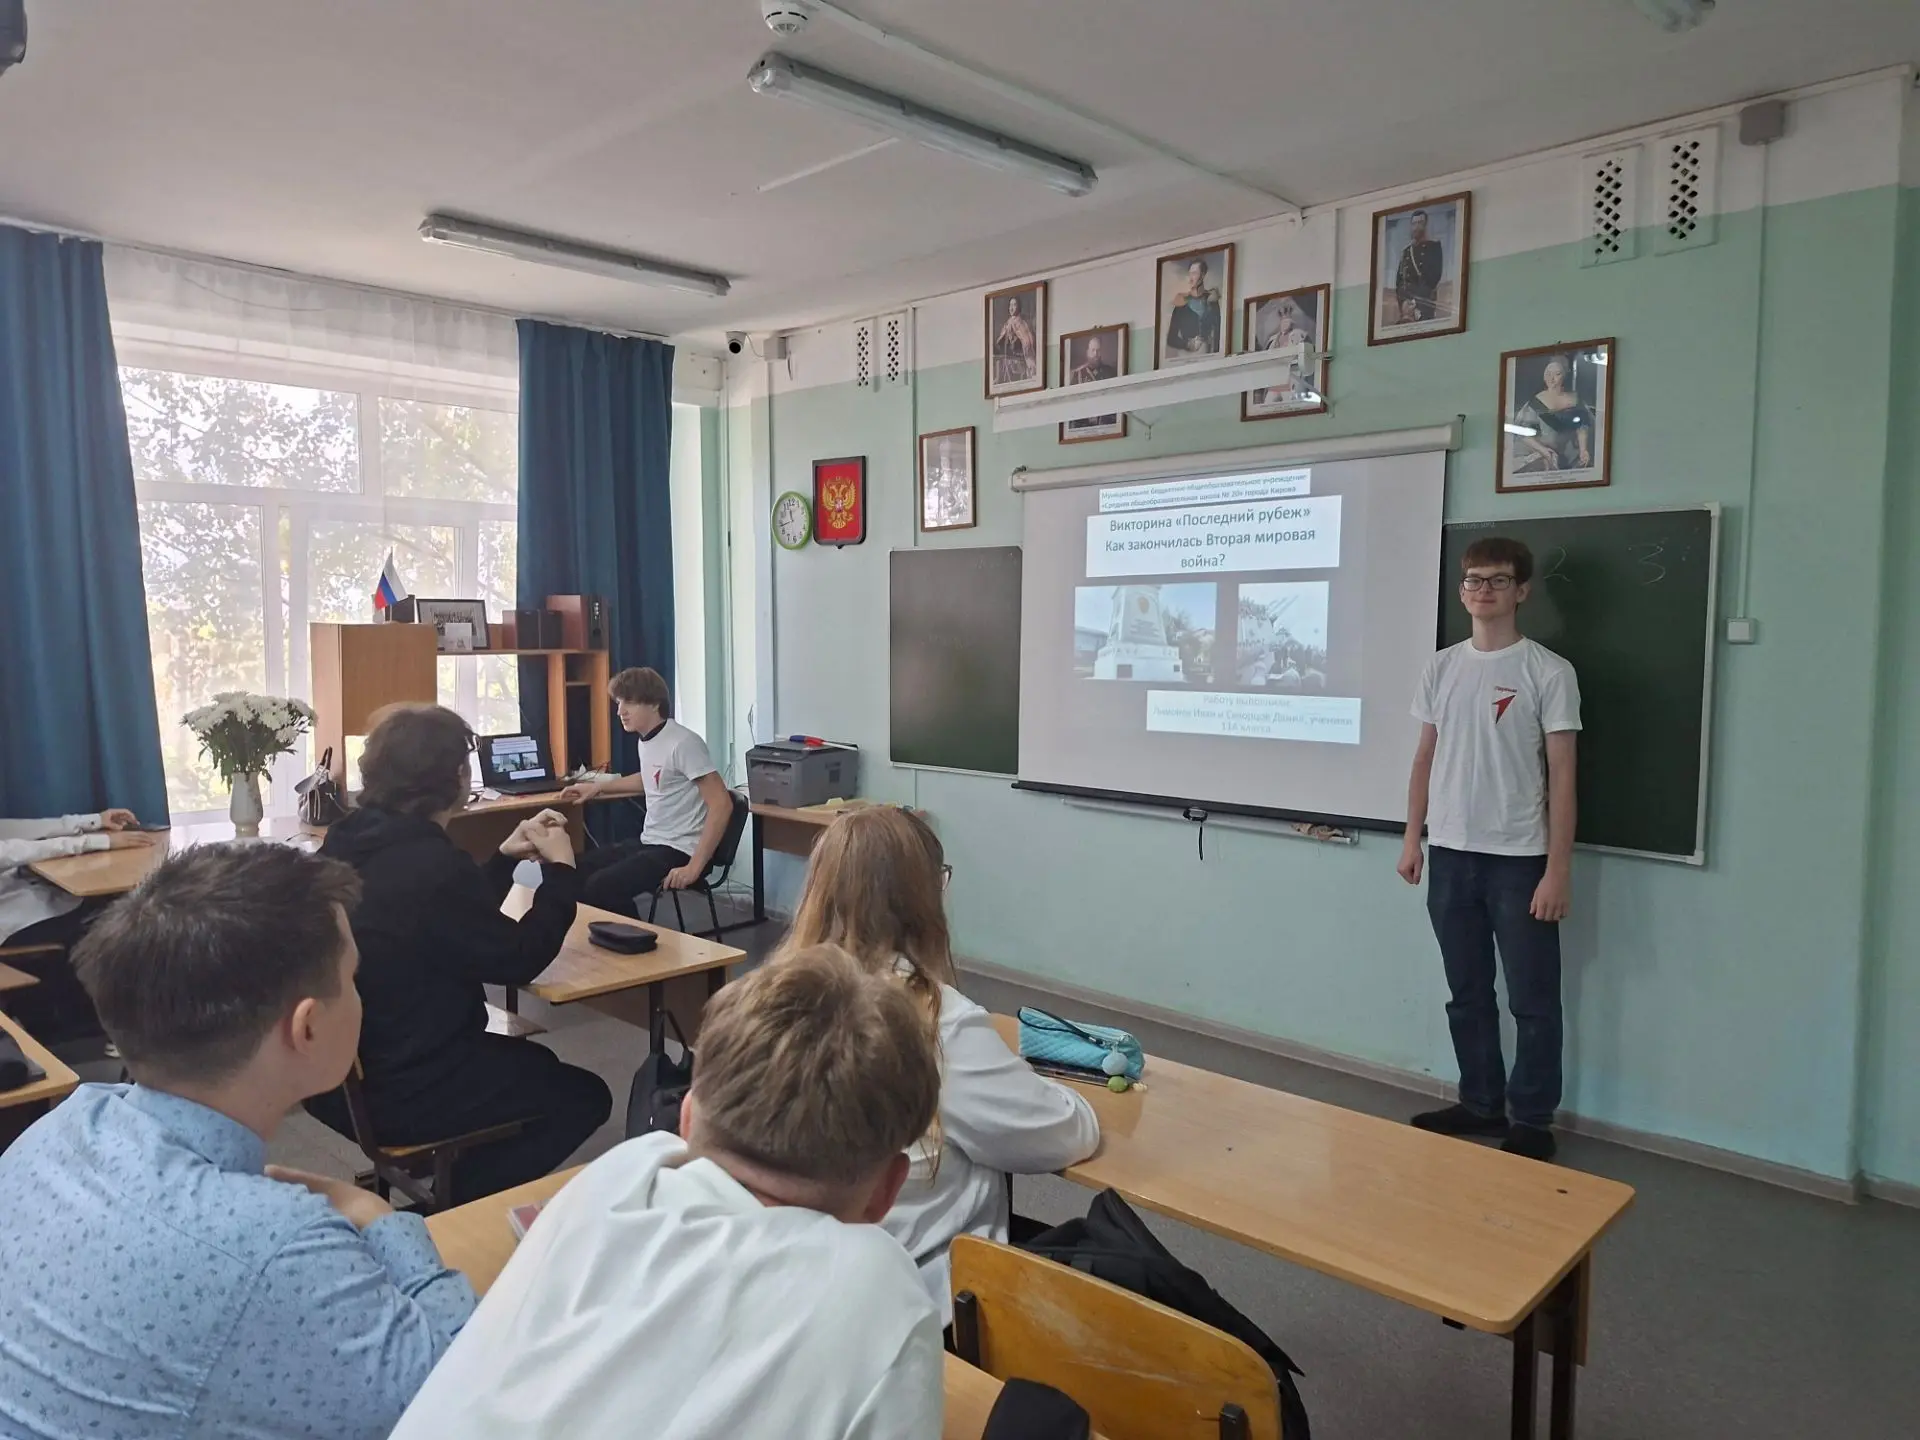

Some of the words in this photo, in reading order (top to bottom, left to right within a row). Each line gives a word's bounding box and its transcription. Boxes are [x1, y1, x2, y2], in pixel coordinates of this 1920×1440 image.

[1270, 485, 1296, 495] Кирова
[1110, 518, 1172, 532] Викторина
[1175, 508, 1255, 528] «Последний
[1258, 505, 1312, 524] рубеж»
[1105, 540, 1125, 552] Как
[1127, 535, 1203, 552] закончилась
[1206, 533, 1251, 547] Вторая
[1254, 529, 1316, 545] мировая
[1180, 553, 1226, 569] война?
